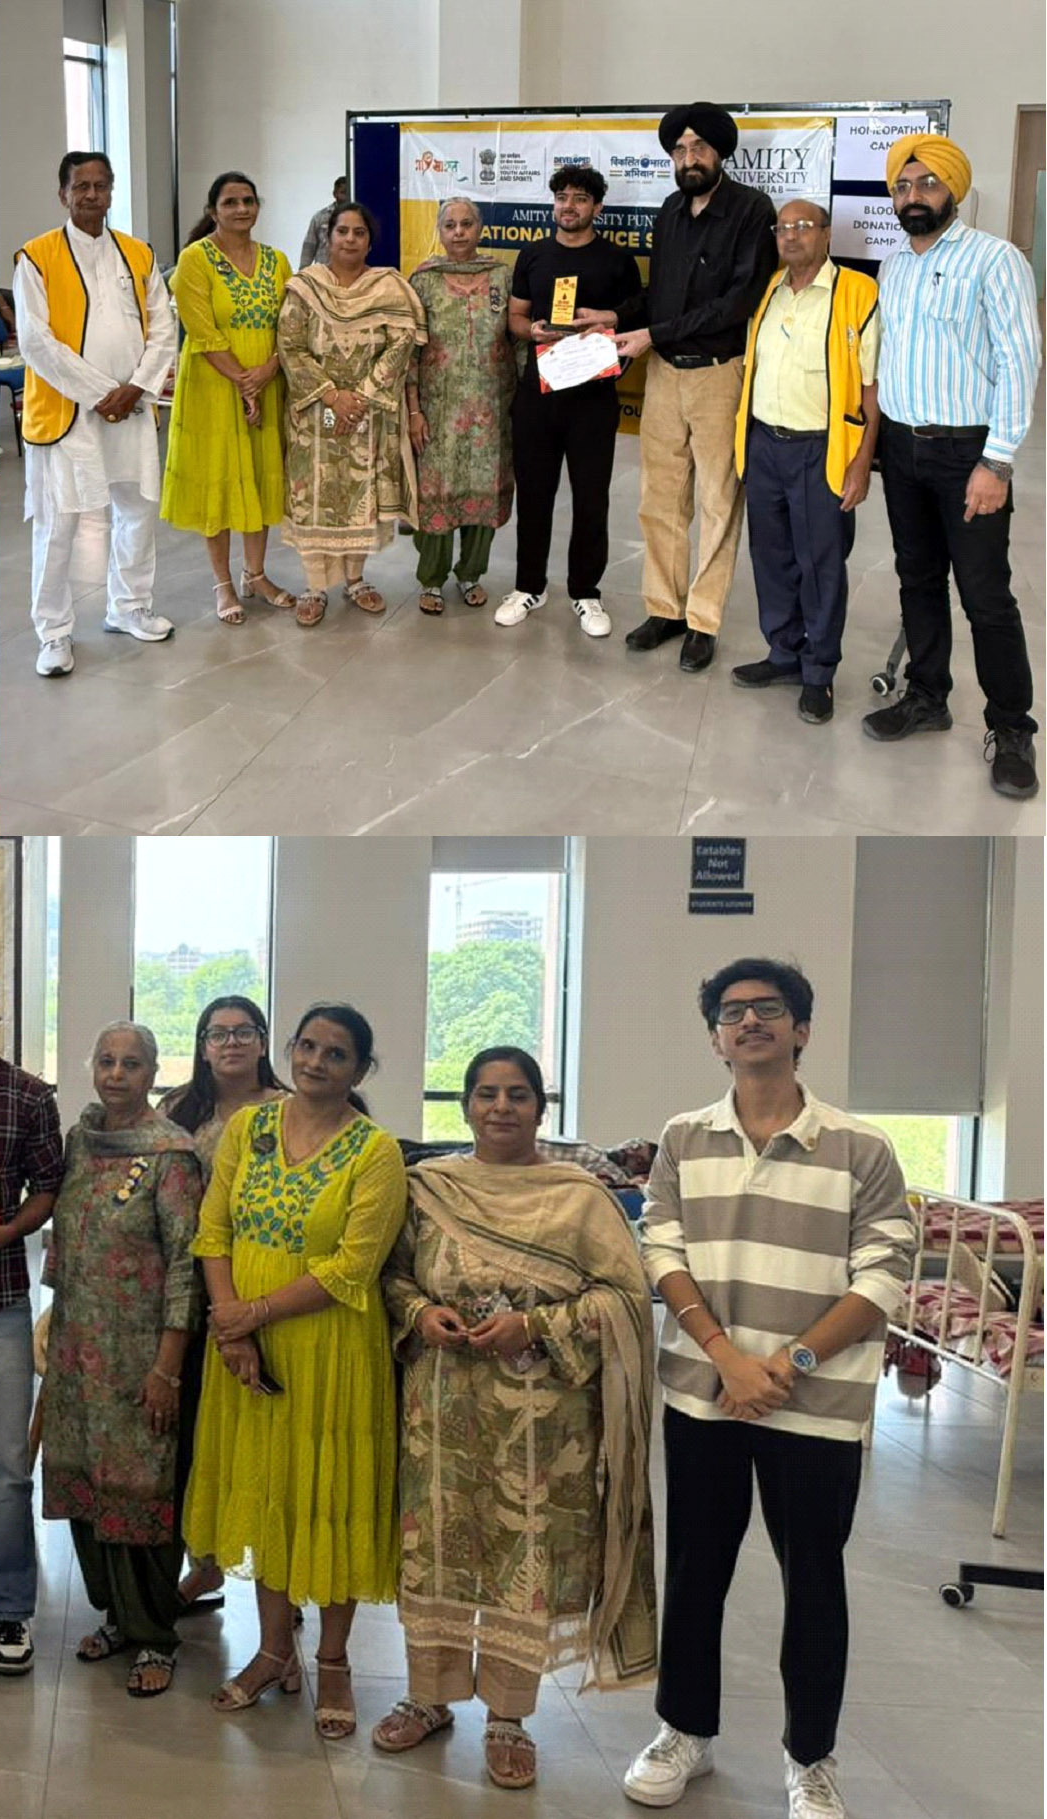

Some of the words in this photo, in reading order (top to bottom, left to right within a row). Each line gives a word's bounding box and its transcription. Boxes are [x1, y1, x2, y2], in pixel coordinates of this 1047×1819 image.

[724, 148, 810, 169] AMITY
[729, 171, 809, 184] NIVERSITY
[512, 209, 550, 222] AMITY
[864, 206, 894, 215] BLOO
[853, 220, 903, 231] DONATIO
[864, 237, 898, 247] CAMP
[620, 404, 641, 418] OU
[696, 846, 741, 856] Eatables
[708, 859, 728, 868] Not
[696, 870, 740, 880] Allowed
